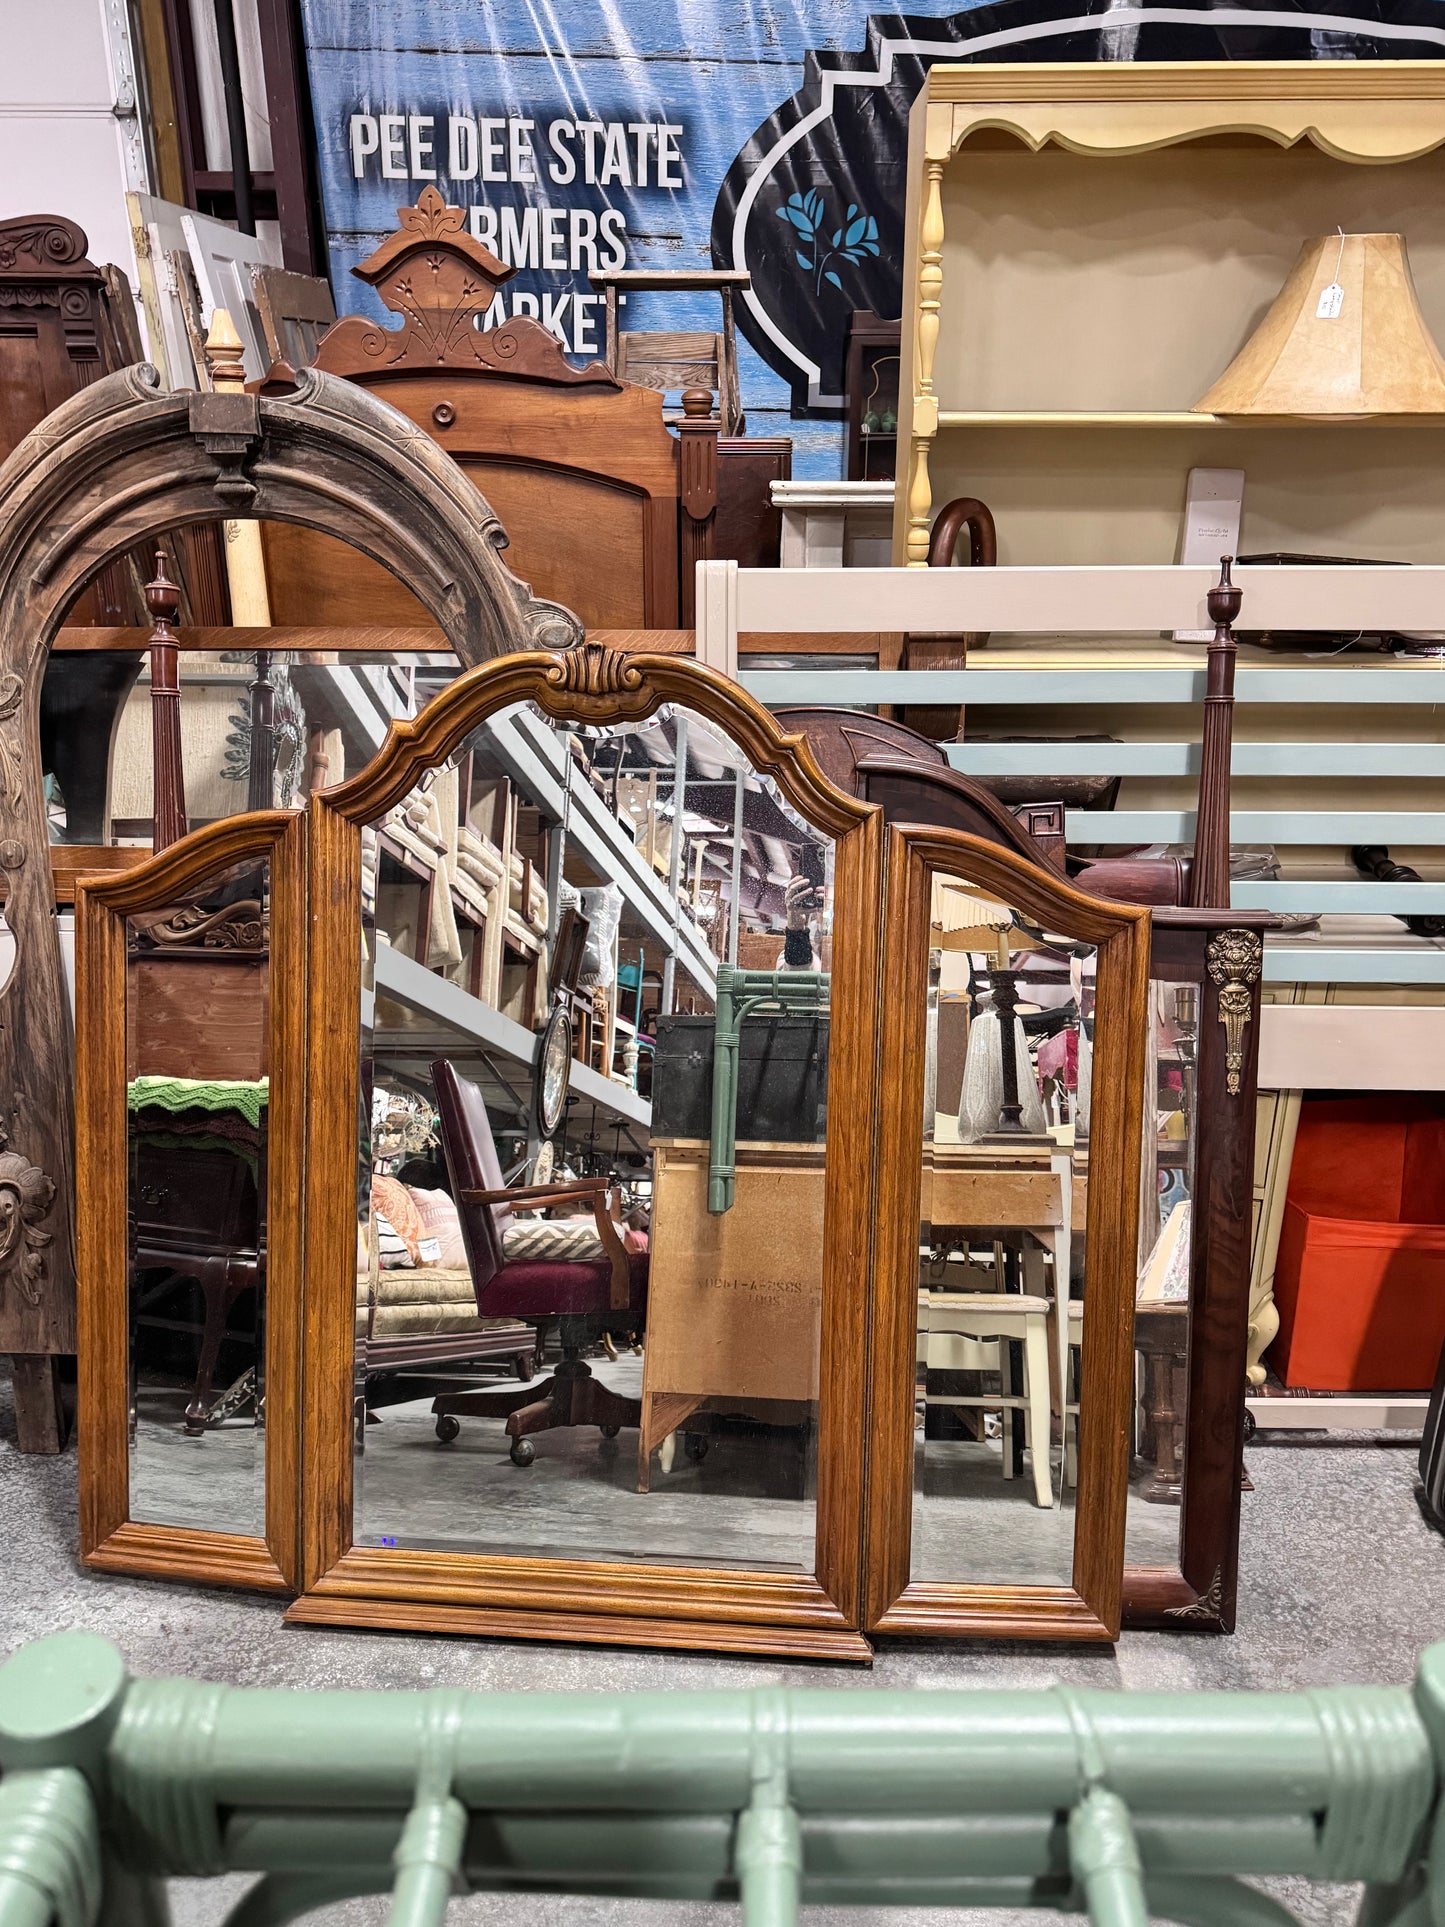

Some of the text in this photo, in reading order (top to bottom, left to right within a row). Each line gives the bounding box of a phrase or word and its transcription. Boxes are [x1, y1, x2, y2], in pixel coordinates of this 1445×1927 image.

[351, 114, 683, 188] PEE DEE STATE
[414, 204, 627, 270] RMERS
[473, 292, 626, 354] AKE
